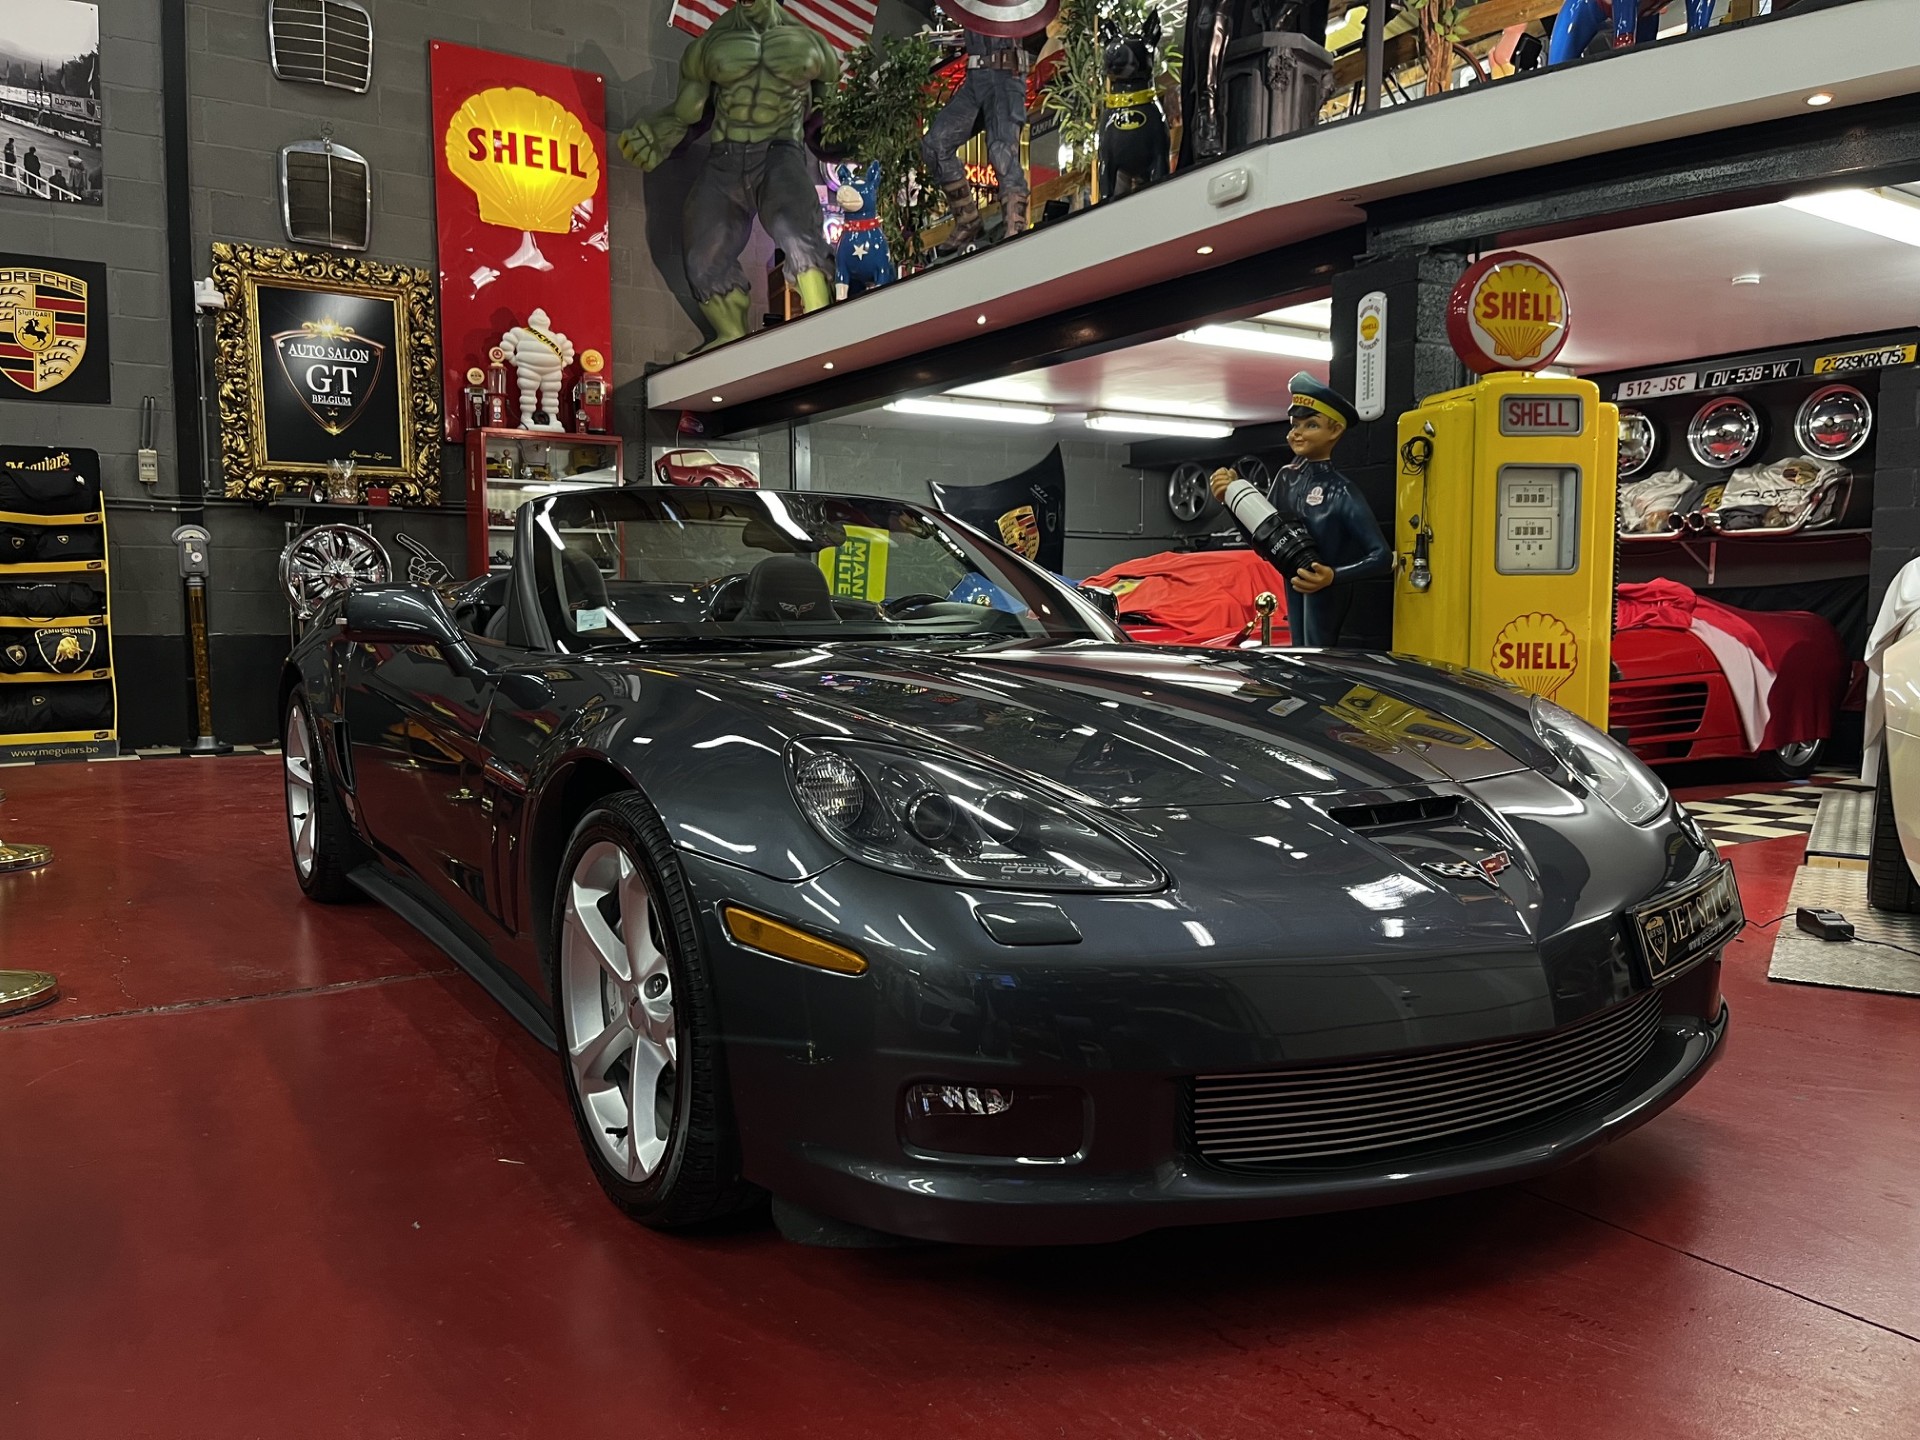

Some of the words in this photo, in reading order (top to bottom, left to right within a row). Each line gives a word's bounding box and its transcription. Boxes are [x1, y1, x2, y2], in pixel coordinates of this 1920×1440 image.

[467, 127, 587, 179] SHELL
[0, 271, 83, 294] ORSCHE
[1481, 291, 1557, 322] SHELL
[288, 343, 325, 357] AUTO
[328, 346, 370, 362] SALON
[305, 364, 358, 395] GT
[1626, 376, 1687, 397] 512-JSC
[1711, 362, 1790, 387] DV-538-YK
[312, 394, 351, 405] BELGIUM
[1508, 402, 1570, 427] SHELL
[838, 541, 853, 595] FILTE
[1499, 642, 1571, 670] SHELL
[11, 745, 99, 758] www.meguiars.be
[1668, 901, 1695, 944] JET
[1696, 888, 1719, 928] SET
